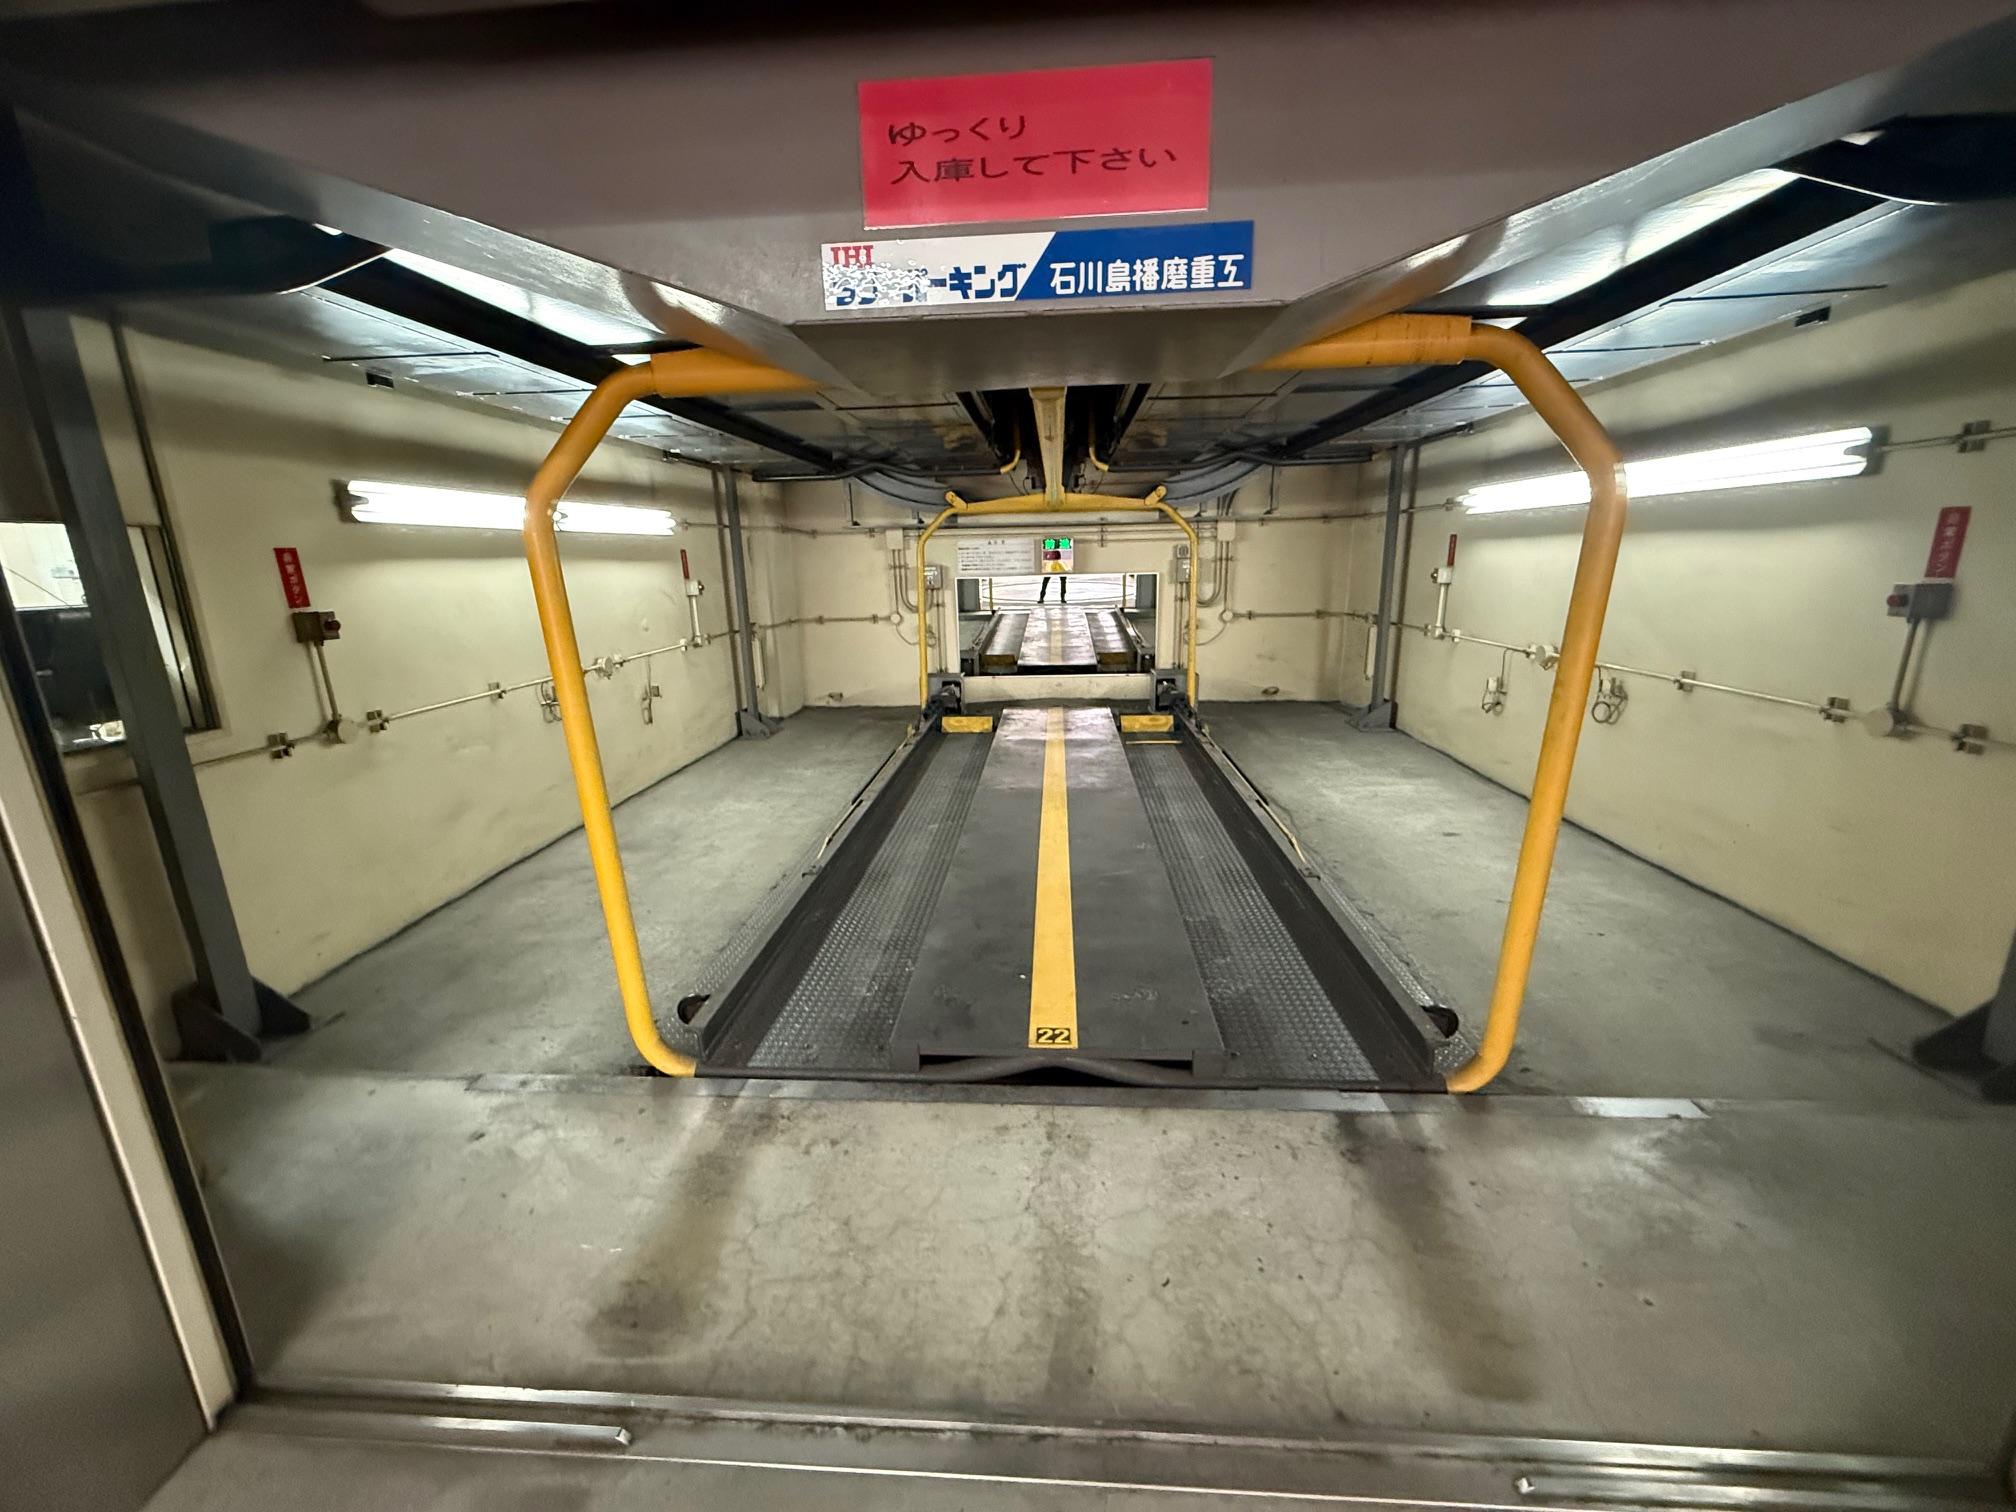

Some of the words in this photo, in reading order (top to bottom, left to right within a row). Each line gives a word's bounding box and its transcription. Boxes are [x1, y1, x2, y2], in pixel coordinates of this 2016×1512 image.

[887, 113, 1027, 147] ゆっくり
[890, 147, 1177, 184] 入庫して下さい
[830, 244, 875, 268] IHI
[1049, 253, 1245, 295] 石川島播磨重工
[1037, 1027, 1070, 1044] 22
